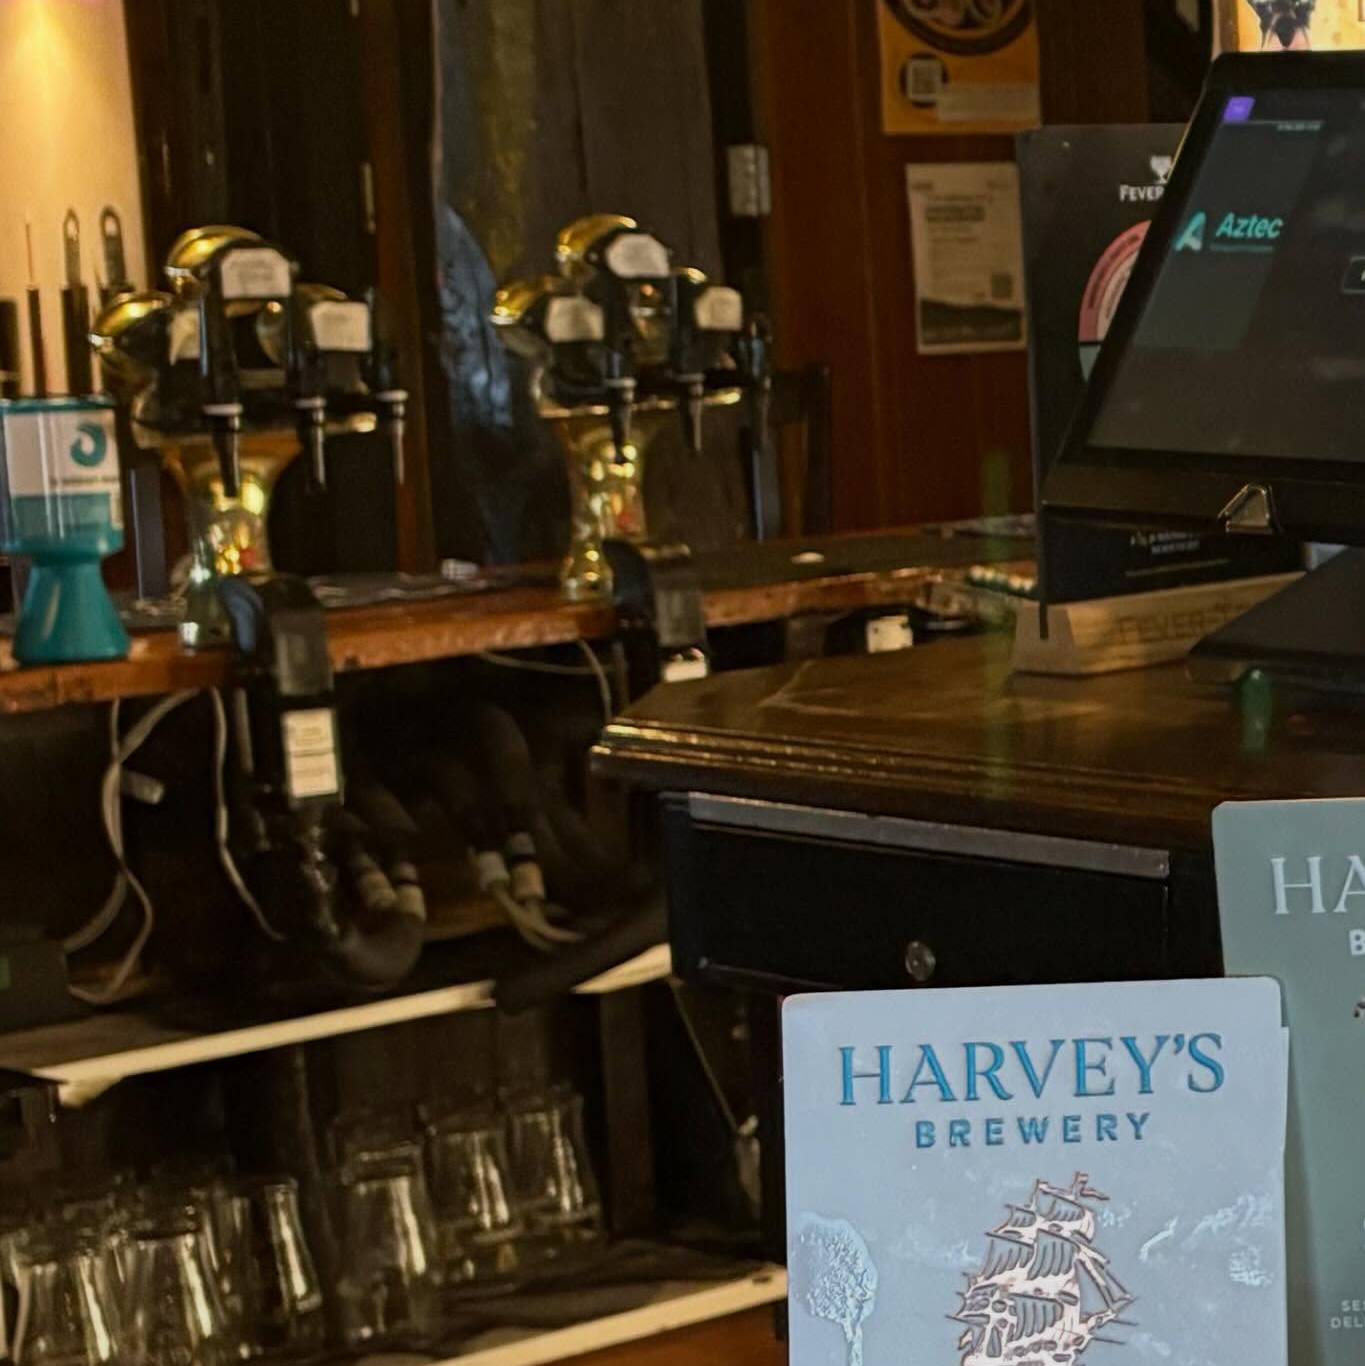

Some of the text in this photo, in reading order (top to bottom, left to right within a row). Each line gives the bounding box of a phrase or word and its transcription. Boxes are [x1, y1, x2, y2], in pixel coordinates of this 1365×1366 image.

[1216, 212, 1284, 239] Aztec
[838, 1032, 1226, 1106] HARVEY'S
[915, 1111, 1152, 1149] BREWERY
